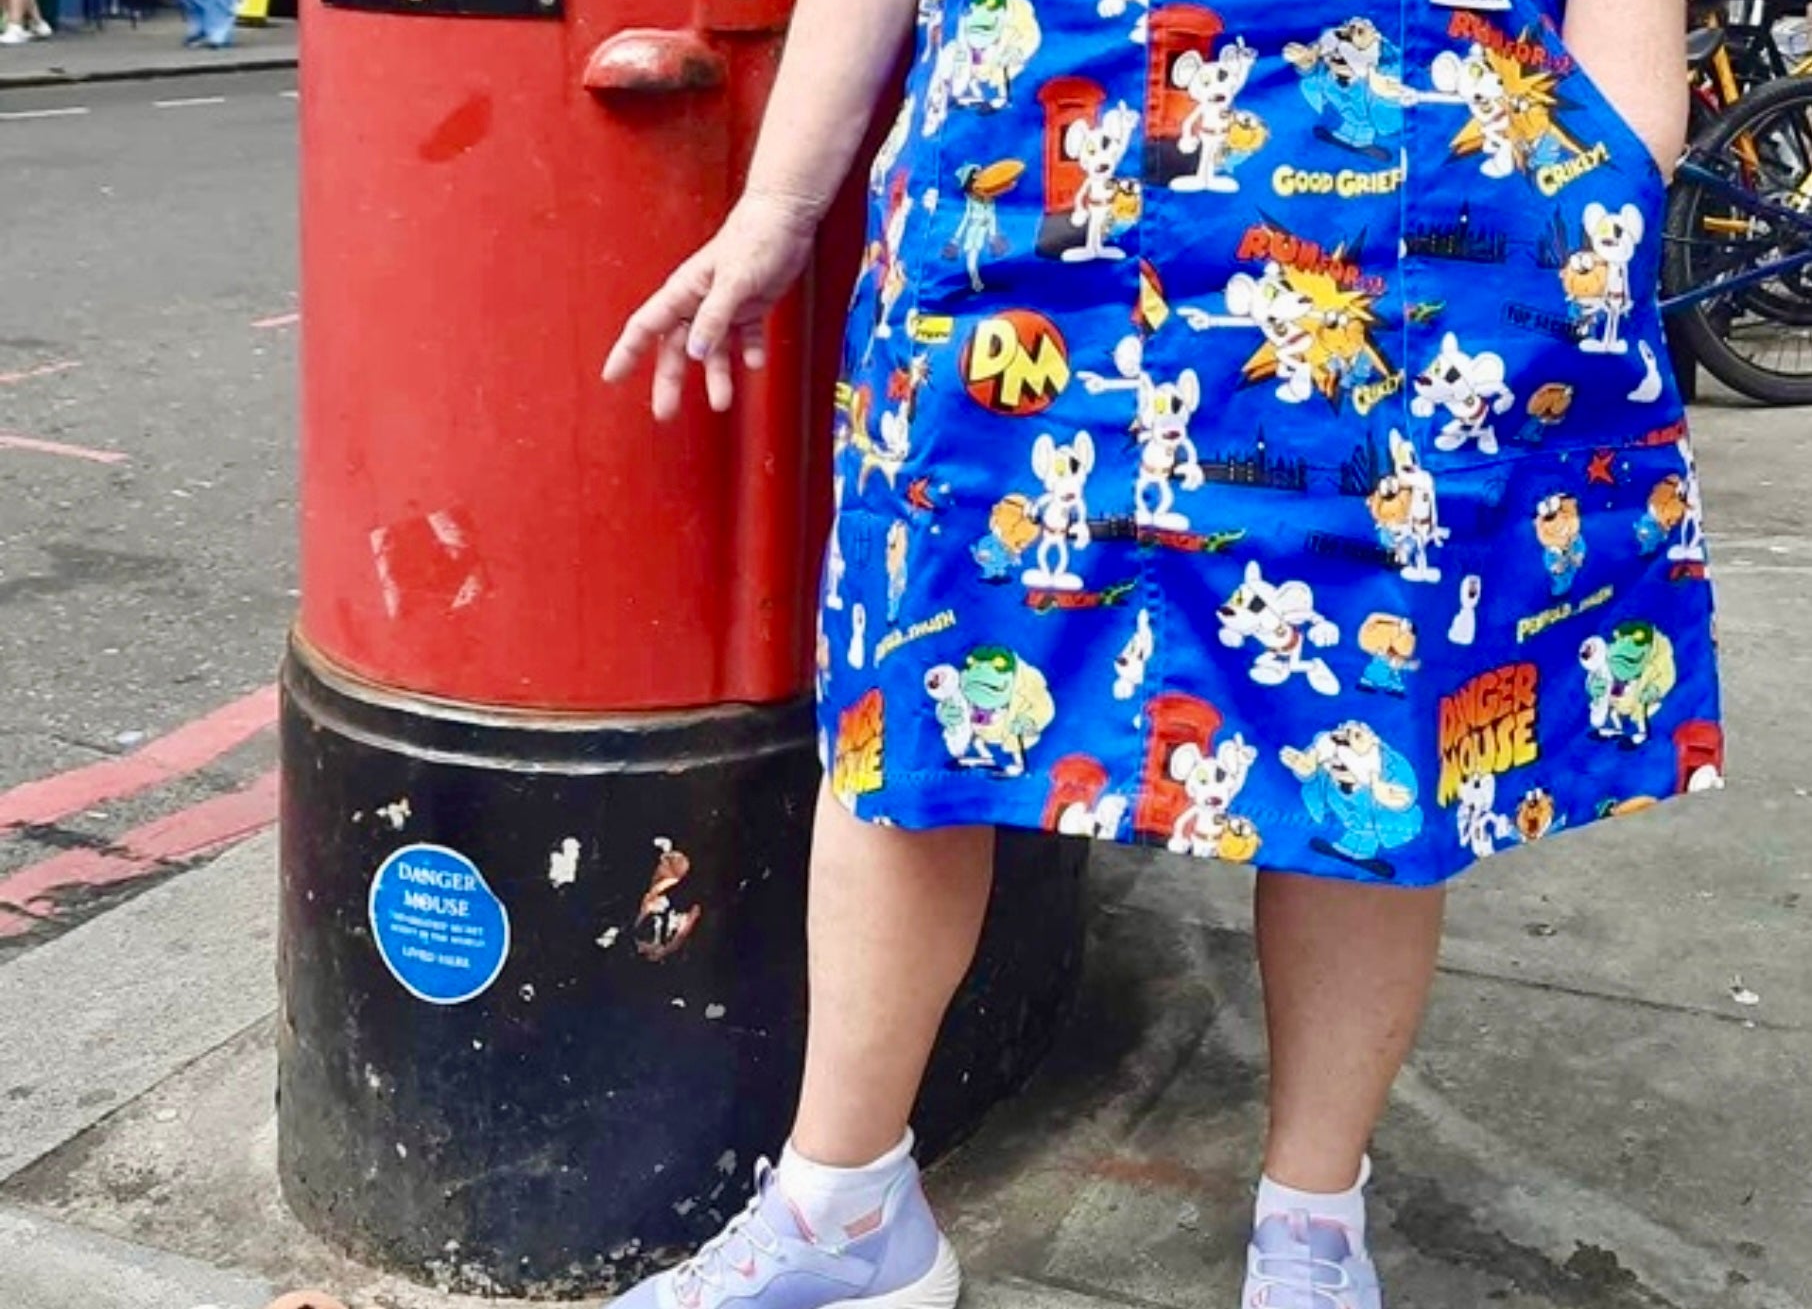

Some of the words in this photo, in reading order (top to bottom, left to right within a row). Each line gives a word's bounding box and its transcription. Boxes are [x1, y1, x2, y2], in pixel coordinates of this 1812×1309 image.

[1272, 163, 1334, 197] GOOD
[969, 318, 1071, 407] DM
[1437, 660, 1539, 754] DANGER
[1436, 707, 1539, 809] MOUSE
[398, 861, 477, 892] DANGER
[402, 889, 470, 918] MOUSE
